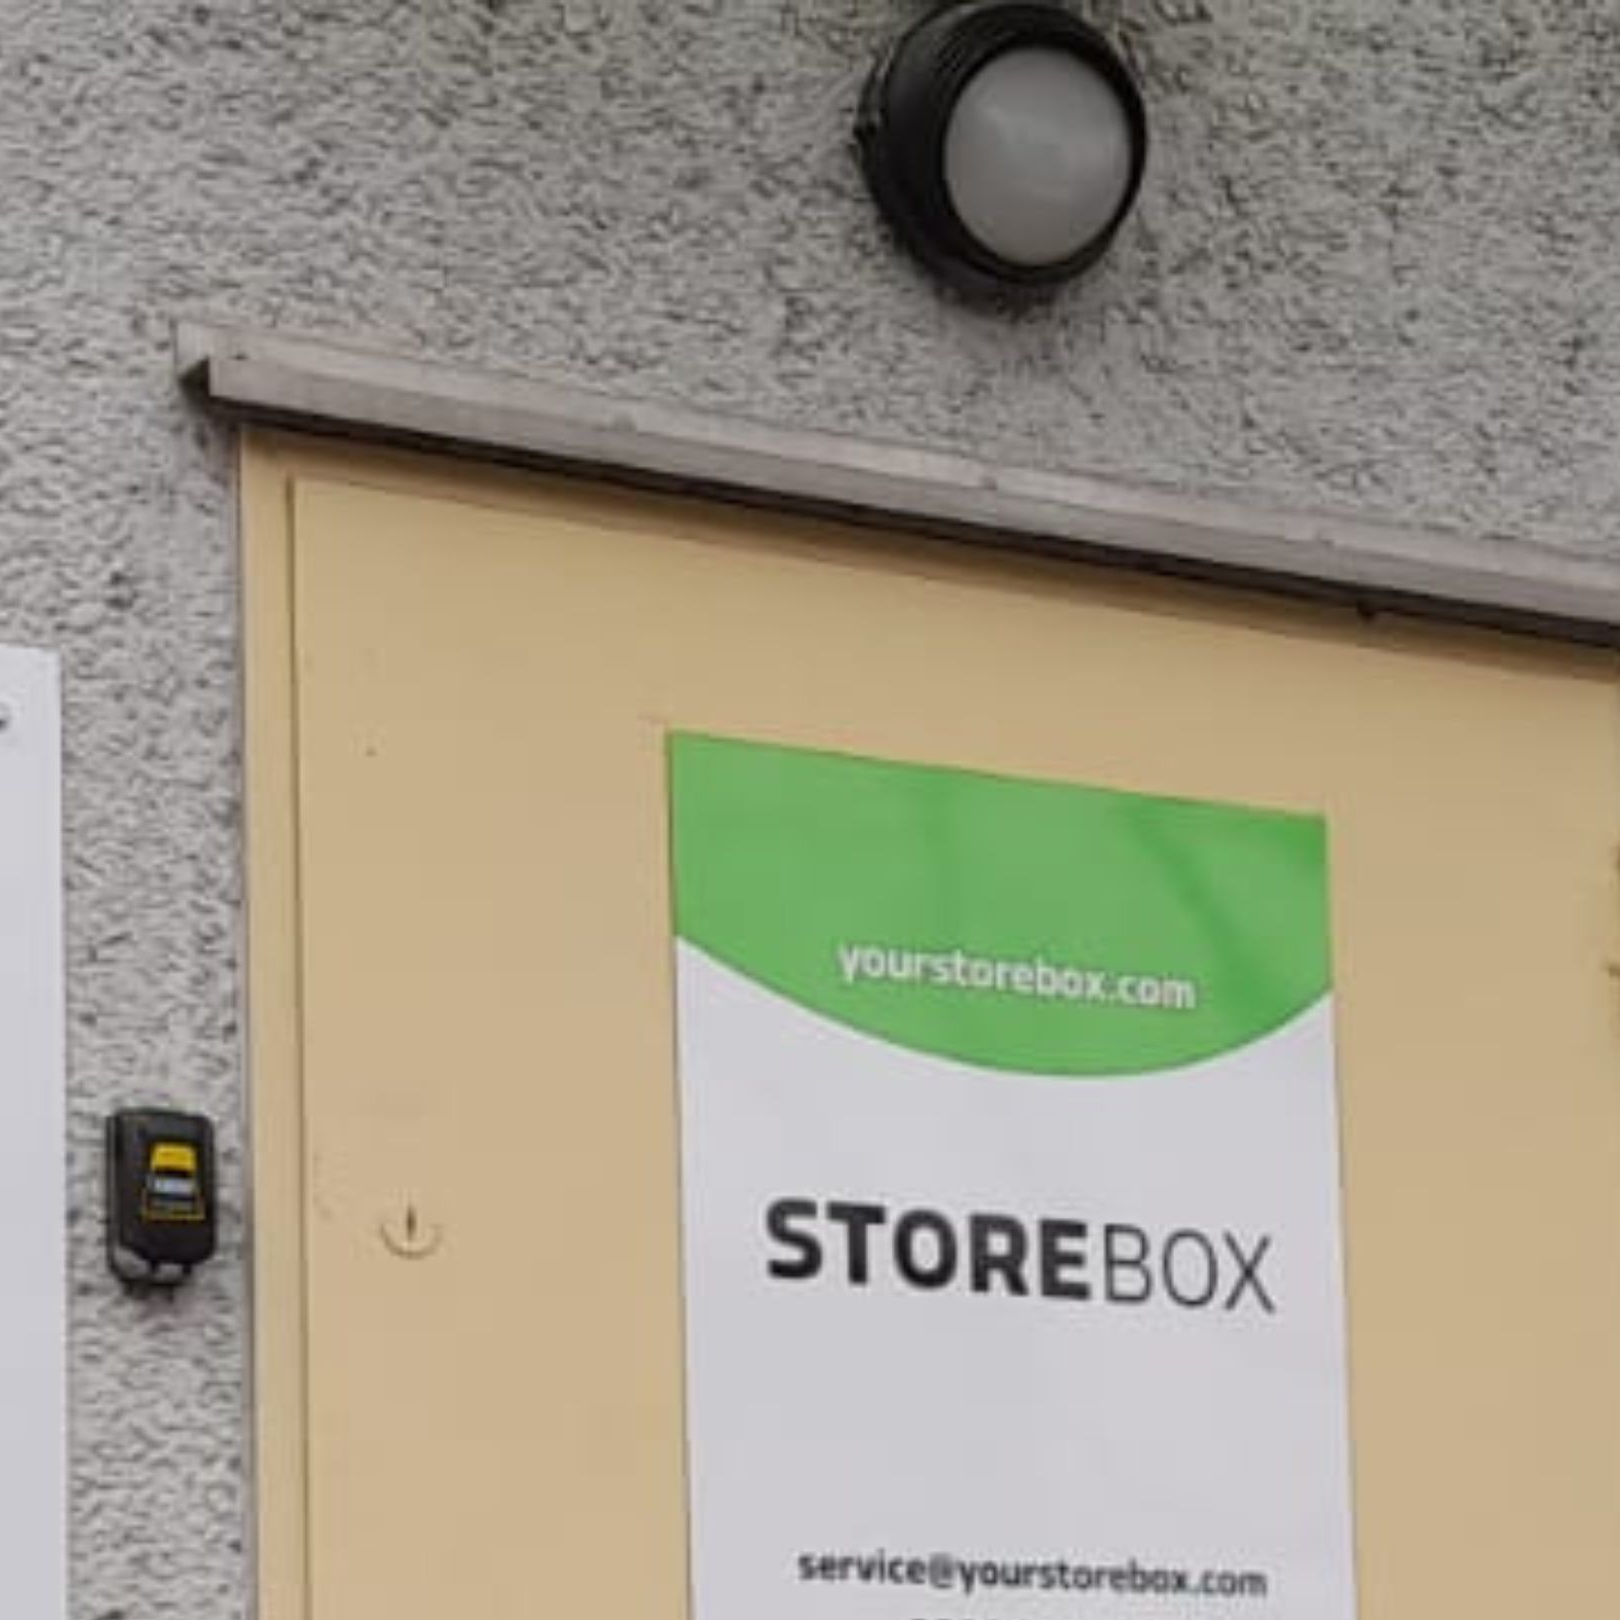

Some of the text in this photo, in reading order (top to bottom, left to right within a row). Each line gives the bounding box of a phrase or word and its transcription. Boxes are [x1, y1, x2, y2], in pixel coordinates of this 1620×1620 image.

[839, 942, 1197, 1010] yourstorebox.com
[764, 1197, 1277, 1314] STOREBOX
[797, 1550, 1268, 1599] service@yourstorebox.com
